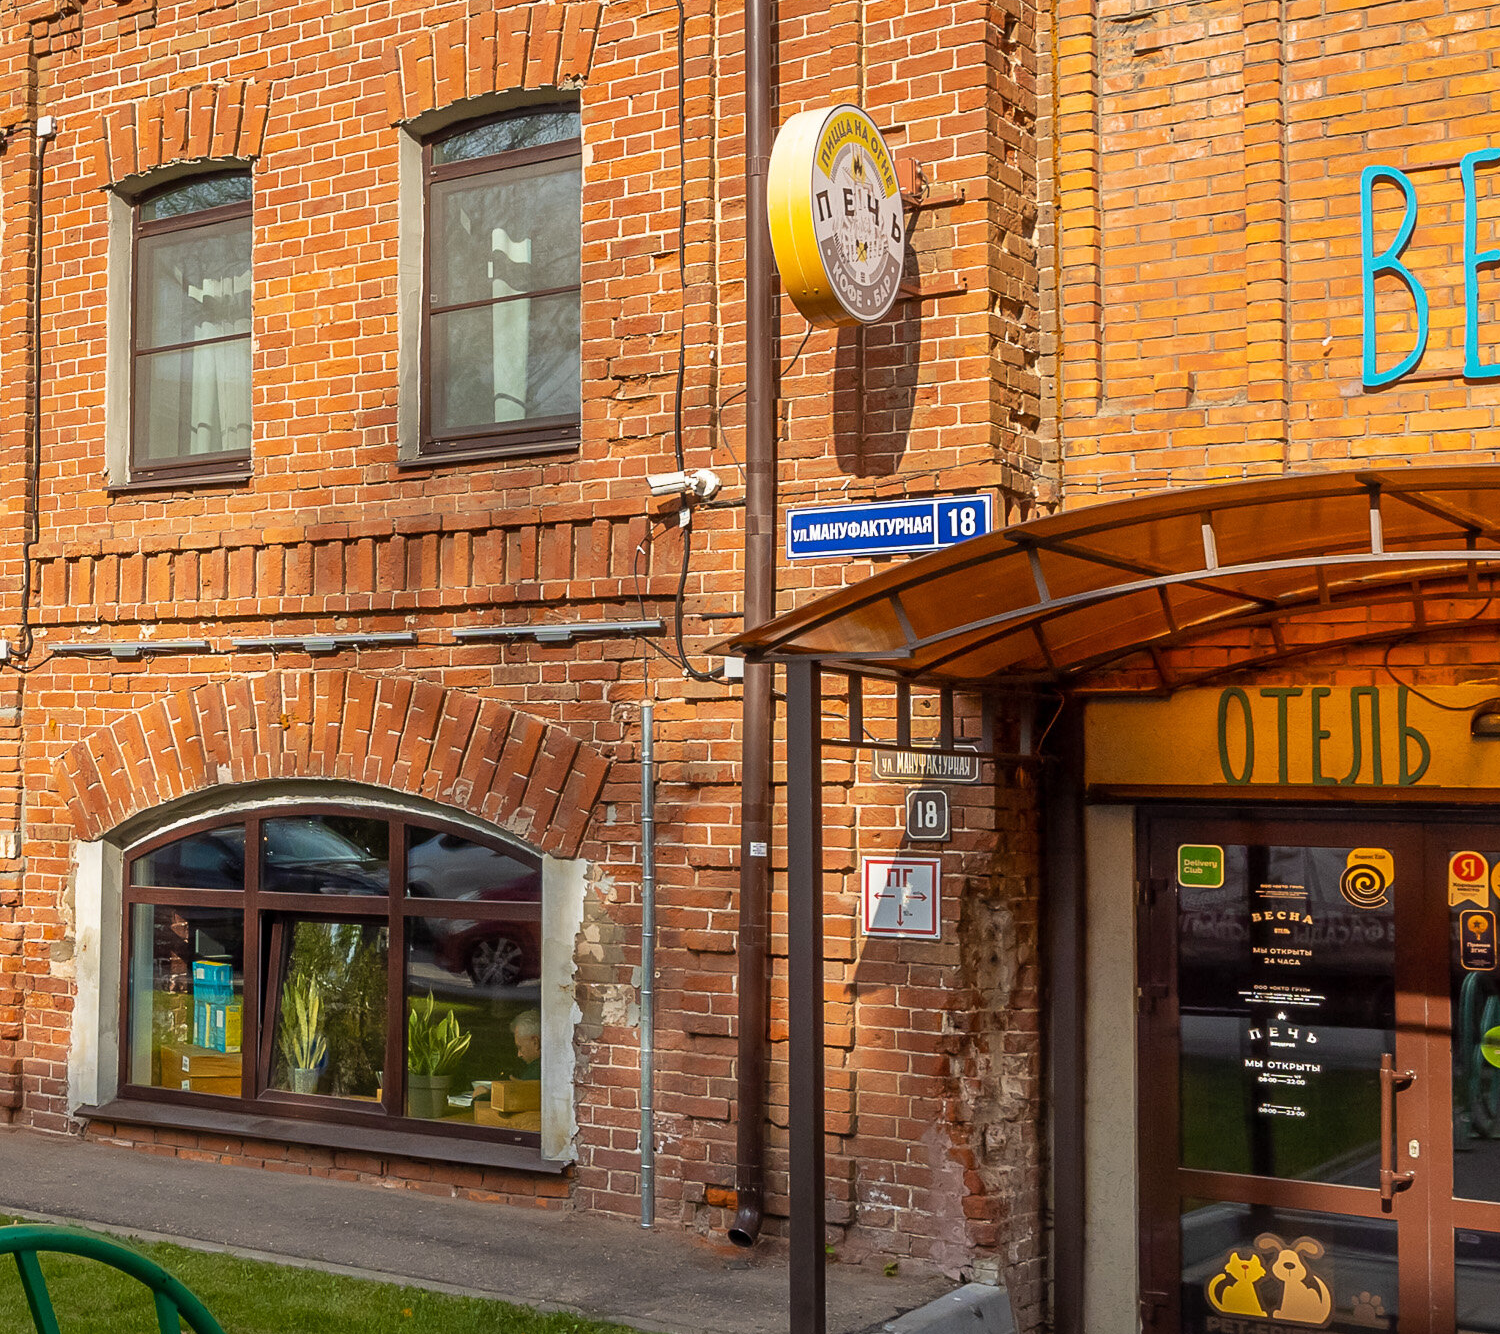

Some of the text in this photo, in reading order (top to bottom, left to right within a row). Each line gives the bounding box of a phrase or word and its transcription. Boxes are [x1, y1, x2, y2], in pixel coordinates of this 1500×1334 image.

[821, 119, 893, 189] ПИЦЦА НА ОГНЕ
[816, 187, 901, 243] ПЕЧЬ
[832, 259, 892, 308] КОФЕ БАР
[947, 506, 977, 537] 18
[1217, 686, 1432, 786] ОТЕЛЬ
[917, 800, 938, 828] 18
[1183, 859, 1218, 869] Delivery
[1461, 858, 1475, 877] Я
[887, 868, 914, 888] ПГ
[1251, 911, 1314, 925] ВЕСНА
[1269, 948, 1313, 957] ОТКРЫТЫ
[1277, 958, 1301, 966] ЧАСА
[1248, 1027, 1318, 1044] ПЕЧЬ
[1244, 1059, 1321, 1072] МЫ ОТКРЫТЫ
